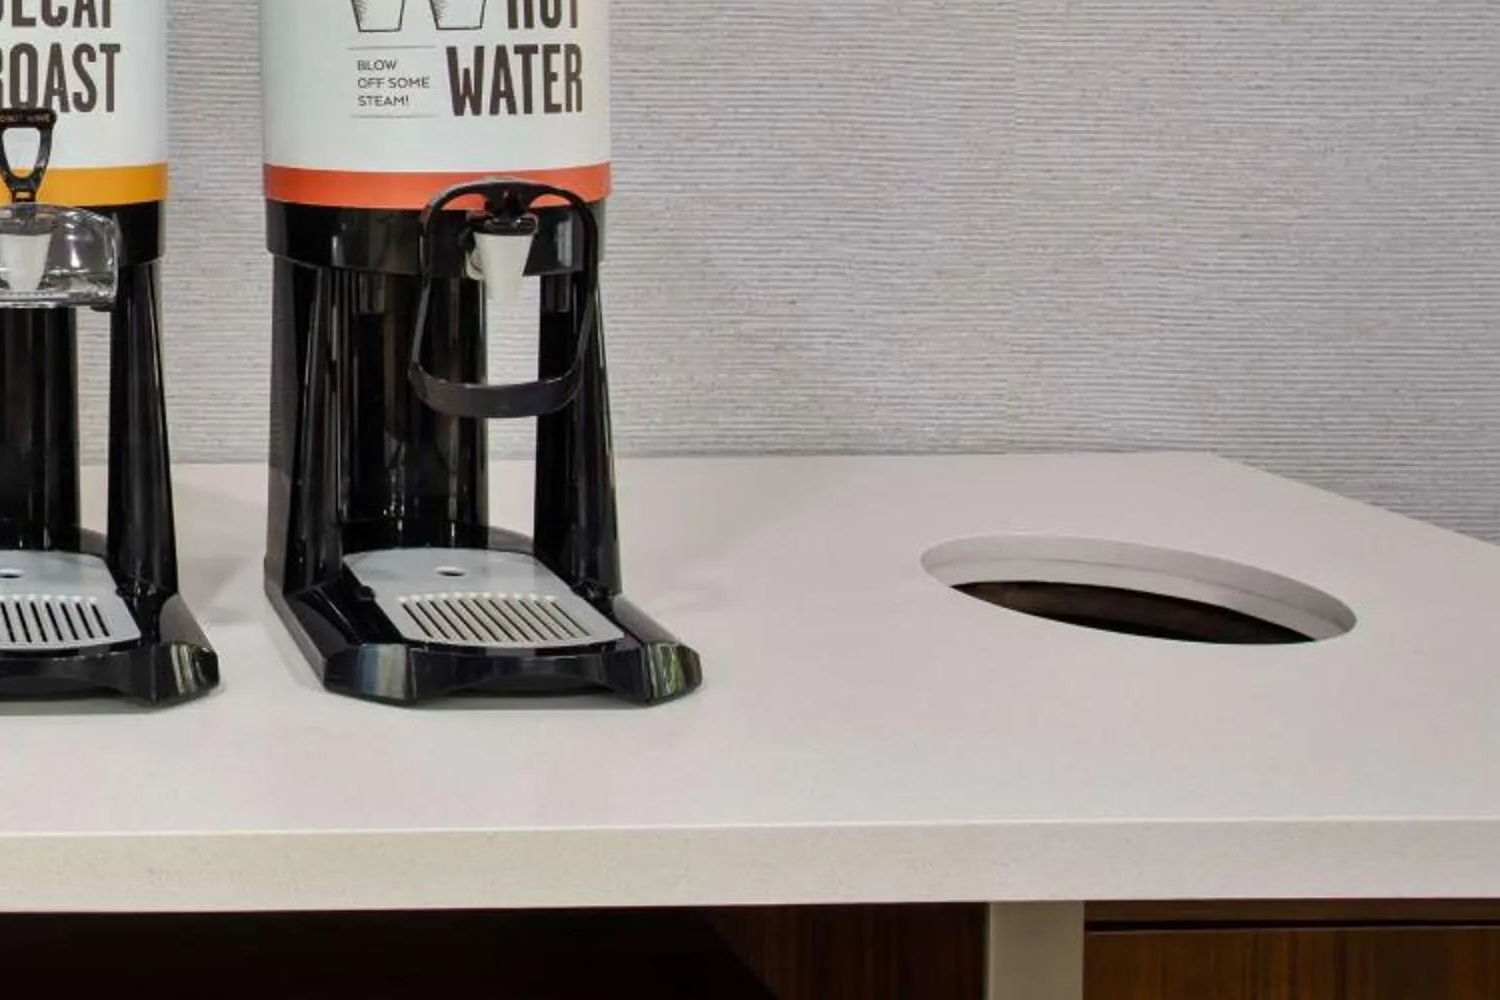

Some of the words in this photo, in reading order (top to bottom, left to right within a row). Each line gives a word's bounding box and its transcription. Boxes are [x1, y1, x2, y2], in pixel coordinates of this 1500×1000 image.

[357, 59, 398, 72] BLOW
[357, 77, 386, 89] OFF
[387, 76, 431, 89] SOME
[445, 43, 584, 117] WATER
[357, 95, 410, 107] STEAM!
